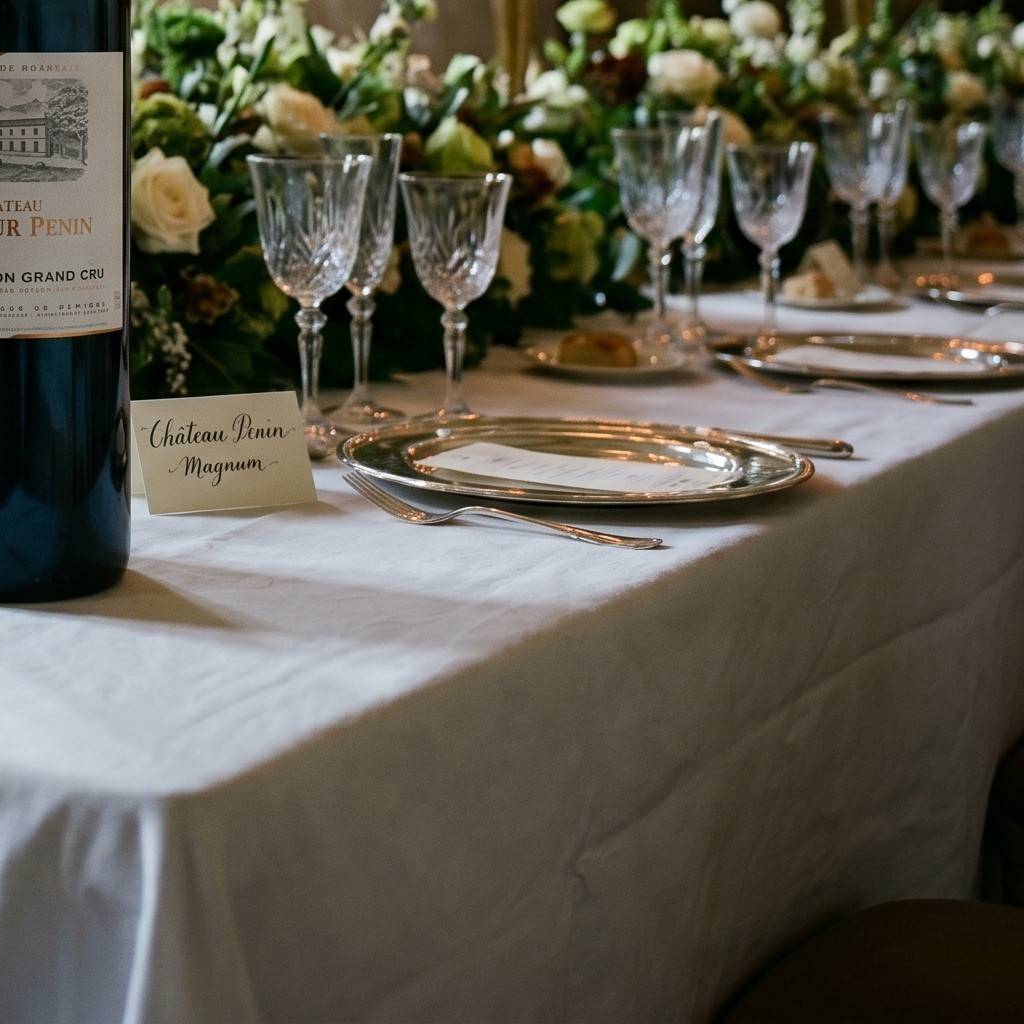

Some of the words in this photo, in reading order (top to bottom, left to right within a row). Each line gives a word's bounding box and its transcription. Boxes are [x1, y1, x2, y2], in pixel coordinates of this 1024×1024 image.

[29, 216, 93, 236] PENIN
[21, 270, 75, 283] GRAND
[80, 268, 105, 280] CRU
[141, 418, 228, 449] Château
[232, 413, 296, 444] Penin
[169, 456, 279, 487] Magnum
